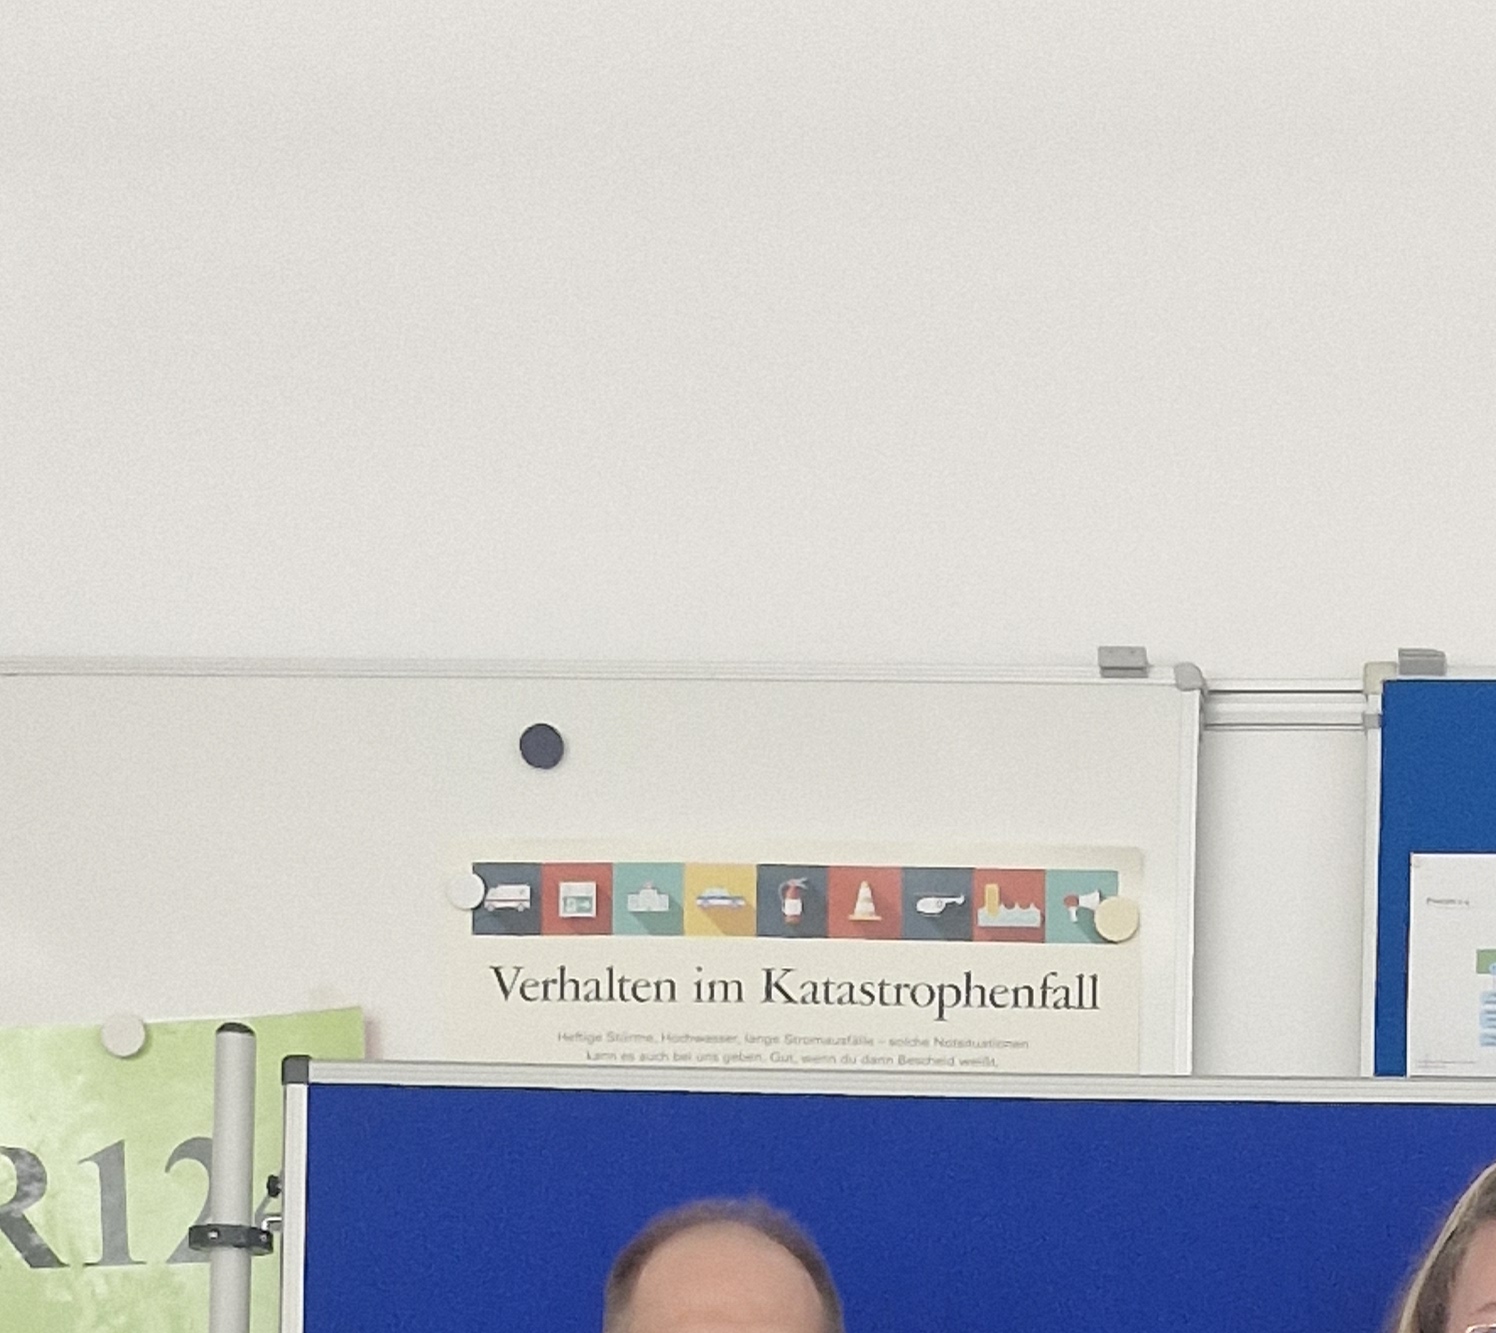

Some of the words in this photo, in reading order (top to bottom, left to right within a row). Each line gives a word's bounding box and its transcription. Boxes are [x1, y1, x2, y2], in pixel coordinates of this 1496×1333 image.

[489, 964, 677, 1003] Verhalten
[693, 965, 745, 1004] im
[761, 966, 1101, 1022] Katastrophenfall
